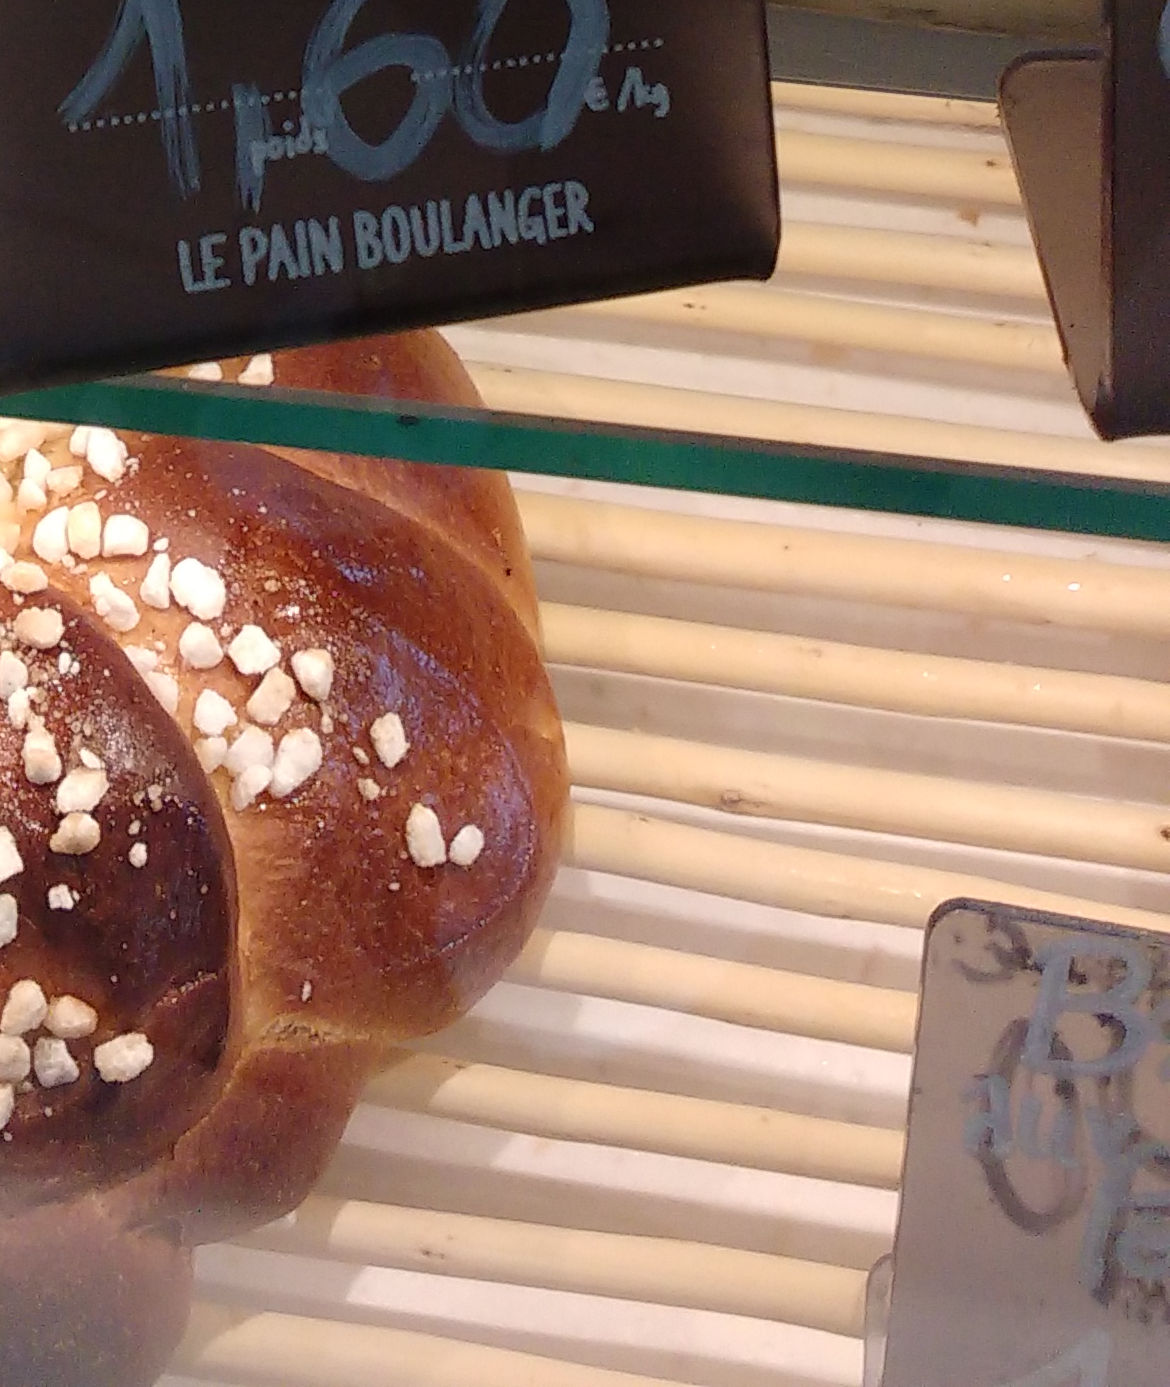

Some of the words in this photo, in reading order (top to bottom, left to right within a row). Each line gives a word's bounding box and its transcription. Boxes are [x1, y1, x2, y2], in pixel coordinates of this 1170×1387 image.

[177, 232, 231, 294] LE
[239, 216, 344, 286] PAIN
[353, 179, 594, 270] BOULANGER
